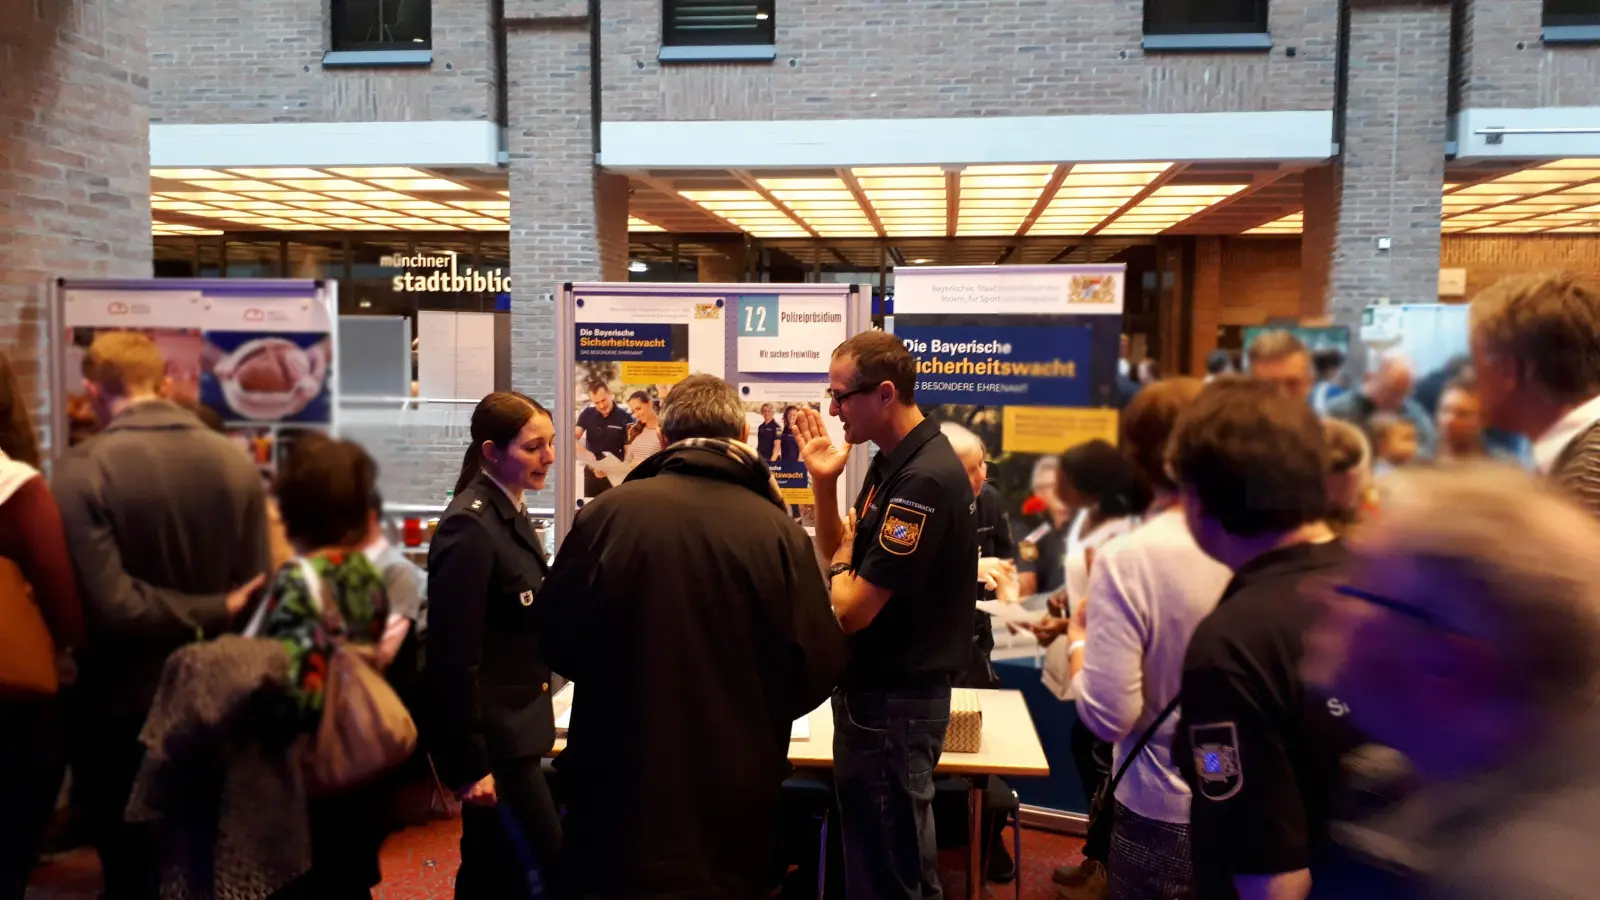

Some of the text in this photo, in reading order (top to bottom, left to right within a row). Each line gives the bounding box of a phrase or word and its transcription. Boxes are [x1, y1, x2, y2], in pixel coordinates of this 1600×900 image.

[781, 311, 842, 323] Polizeipräsidium
[580, 328, 635, 338] Die Bayerische
[580, 337, 665, 348] Sicherheitswacht
[903, 339, 1012, 356] Die Bayerische
[759, 350, 820, 359] Wir suchen Freiwillige
[914, 357, 1076, 377] icherheitswacht
[921, 382, 974, 392] BESONDERE
